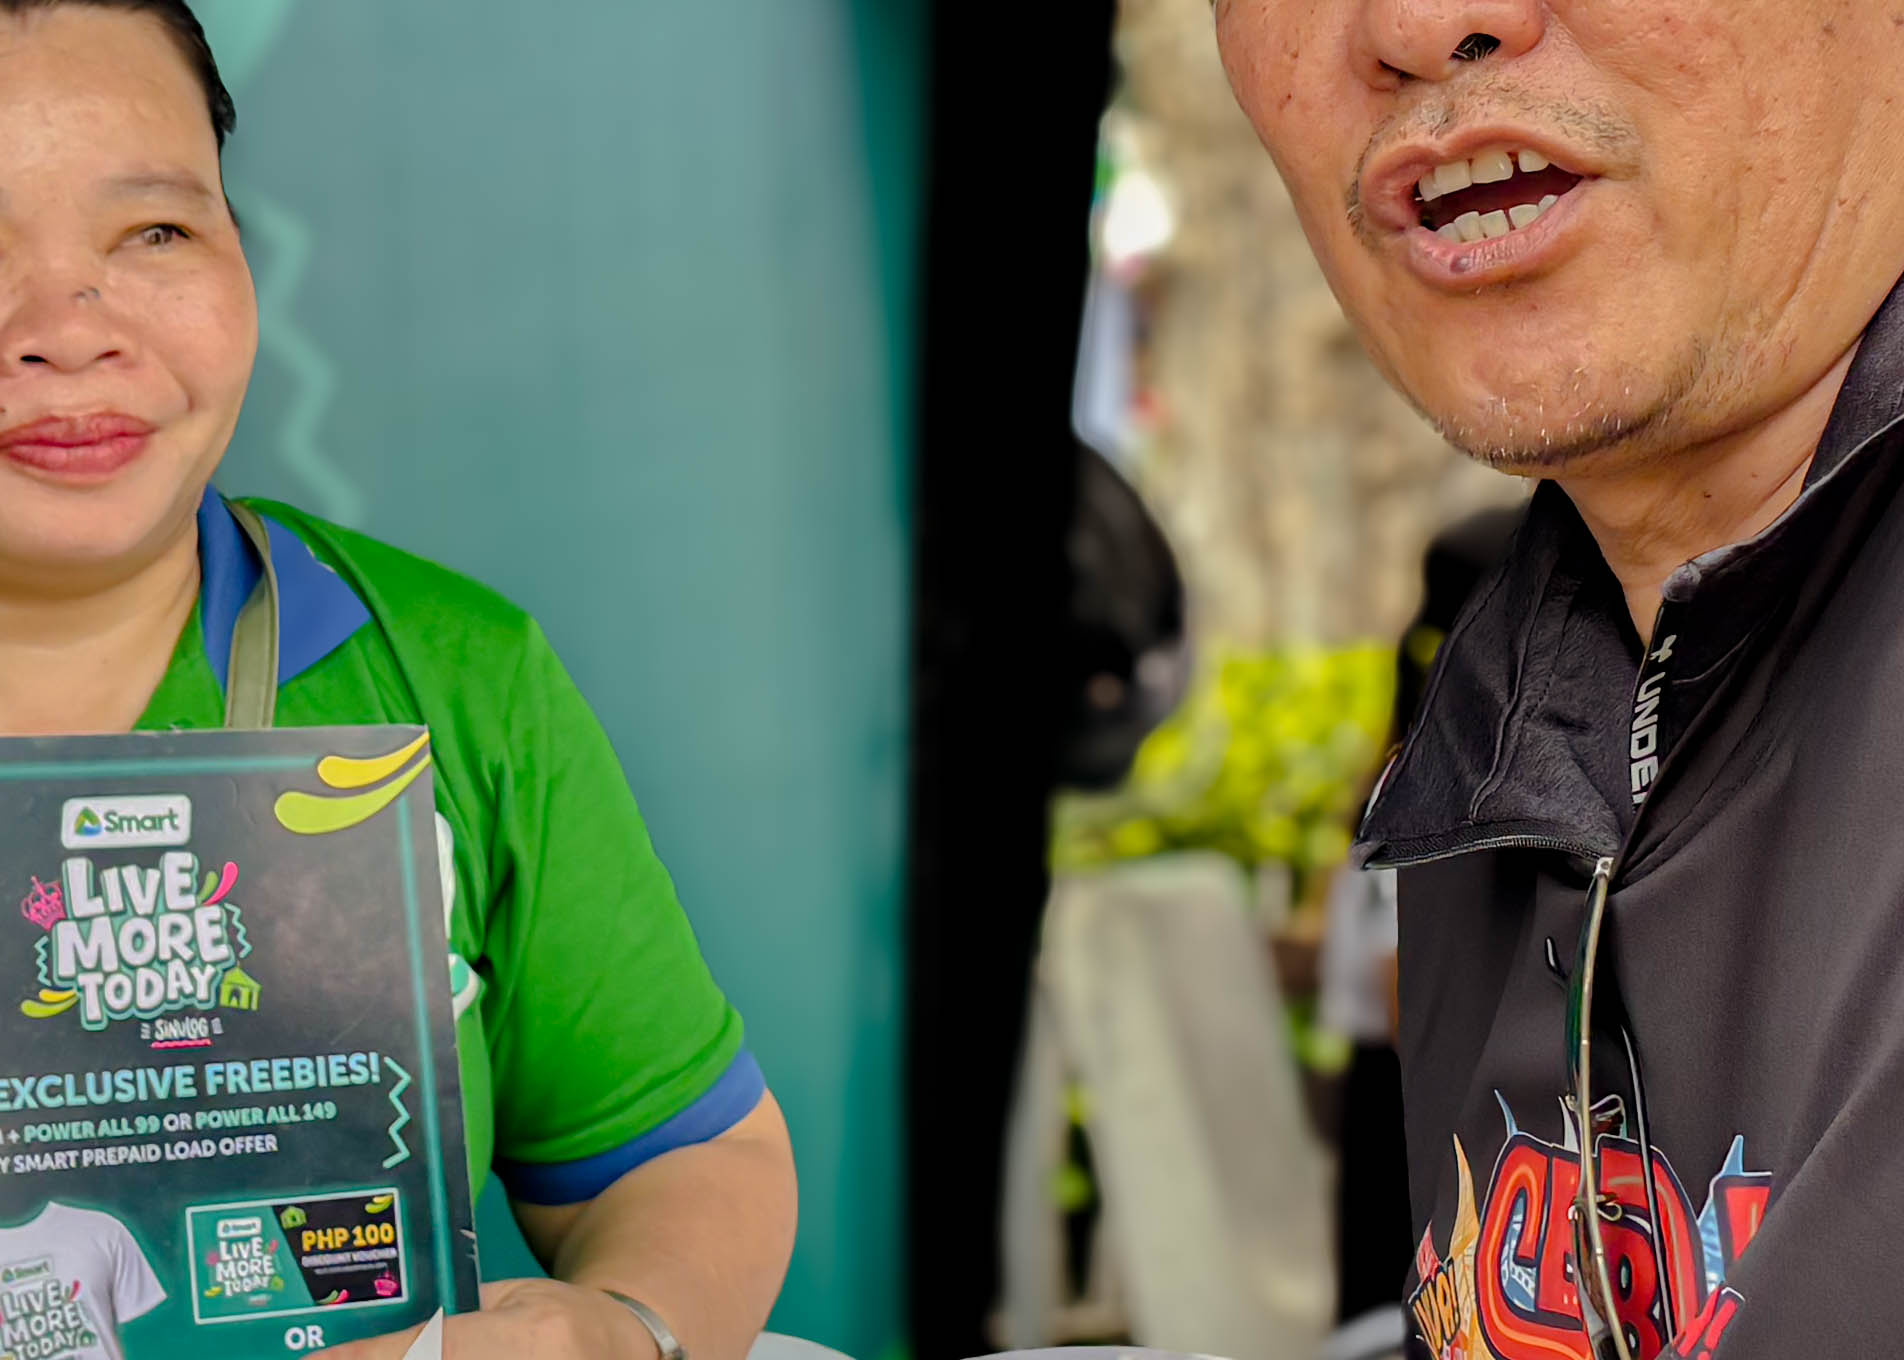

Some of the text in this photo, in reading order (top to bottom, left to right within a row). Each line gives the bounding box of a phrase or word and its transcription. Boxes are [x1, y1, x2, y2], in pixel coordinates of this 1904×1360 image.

[103, 807, 180, 834] Smart
[65, 850, 197, 919] LIVE
[57, 904, 230, 978] MORE
[77, 958, 216, 1022] TODAY
[203, 1051, 381, 1097] FREEBIES!
[7, 1129, 21, 1144] +
[23, 1120, 96, 1144] POWER
[98, 1116, 134, 1138] ALL
[134, 1115, 161, 1135] 99
[163, 1113, 193, 1133] OR
[195, 1106, 265, 1131] POWER
[266, 1103, 301, 1125] ALL
[301, 1101, 338, 1122] 149
[13, 1149, 81, 1174] SMART
[82, 1143, 163, 1168] PREPAID
[164, 1140, 217, 1162] LOAD
[218, 1133, 279, 1157] OFFER
[218, 1236, 264, 1262] LIVE
[301, 1221, 395, 1253] PHP 100
[215, 1254, 275, 1282] MORE
[1, 1279, 62, 1319] LIVE
[2, 1302, 81, 1349] MORE
[284, 1324, 326, 1351] OR
